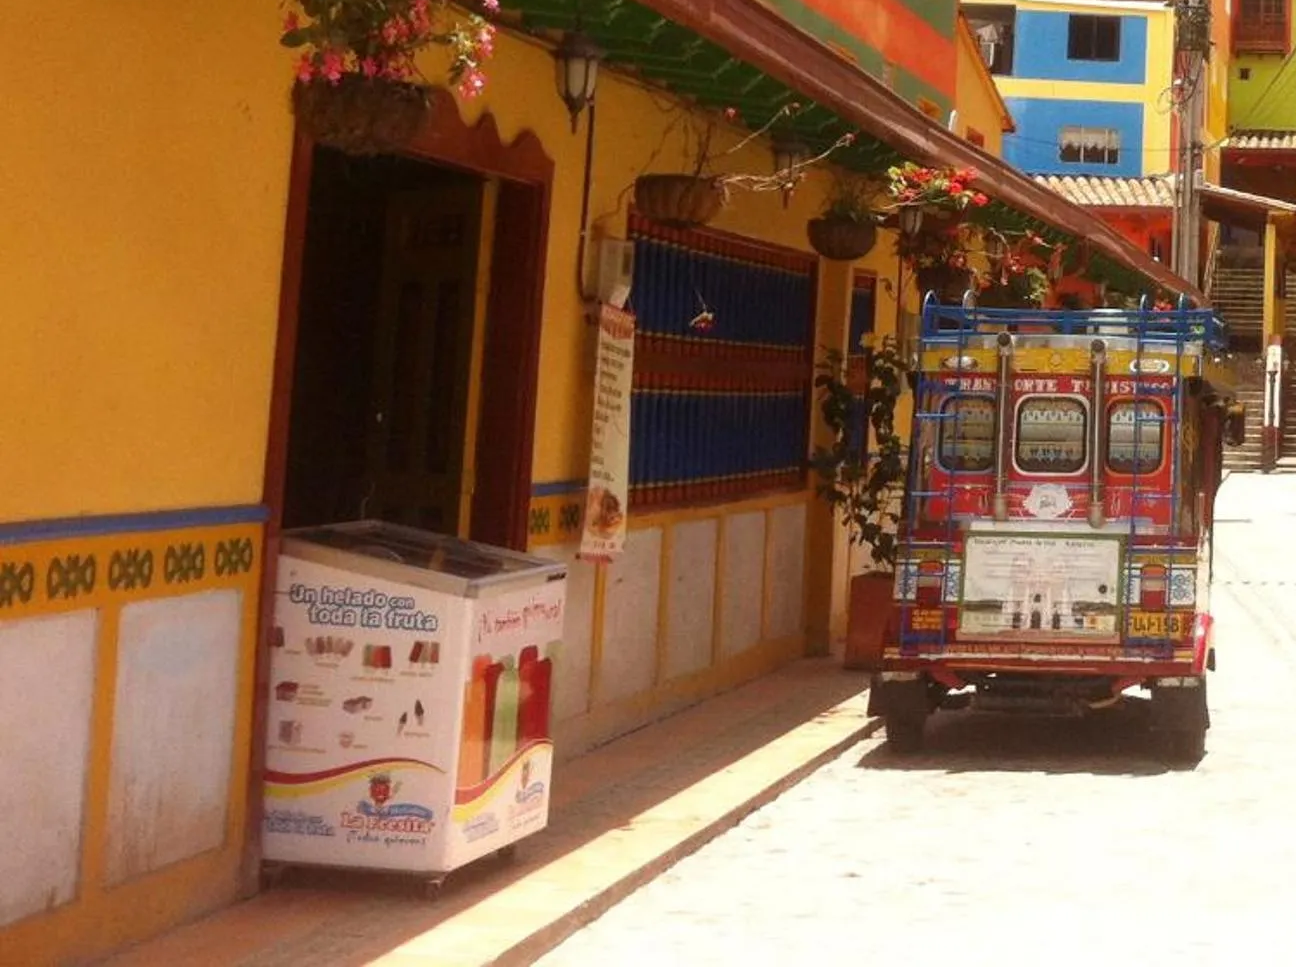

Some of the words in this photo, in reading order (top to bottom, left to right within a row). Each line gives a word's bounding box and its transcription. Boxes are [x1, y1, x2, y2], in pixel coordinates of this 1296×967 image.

[944, 377, 1058, 392] TRANORTE
[289, 583, 317, 603] Un
[320, 586, 387, 608] helado
[387, 596, 416, 610] con
[308, 603, 357, 625] toda
[360, 608, 382, 628] la
[384, 609, 439, 632] fruta
